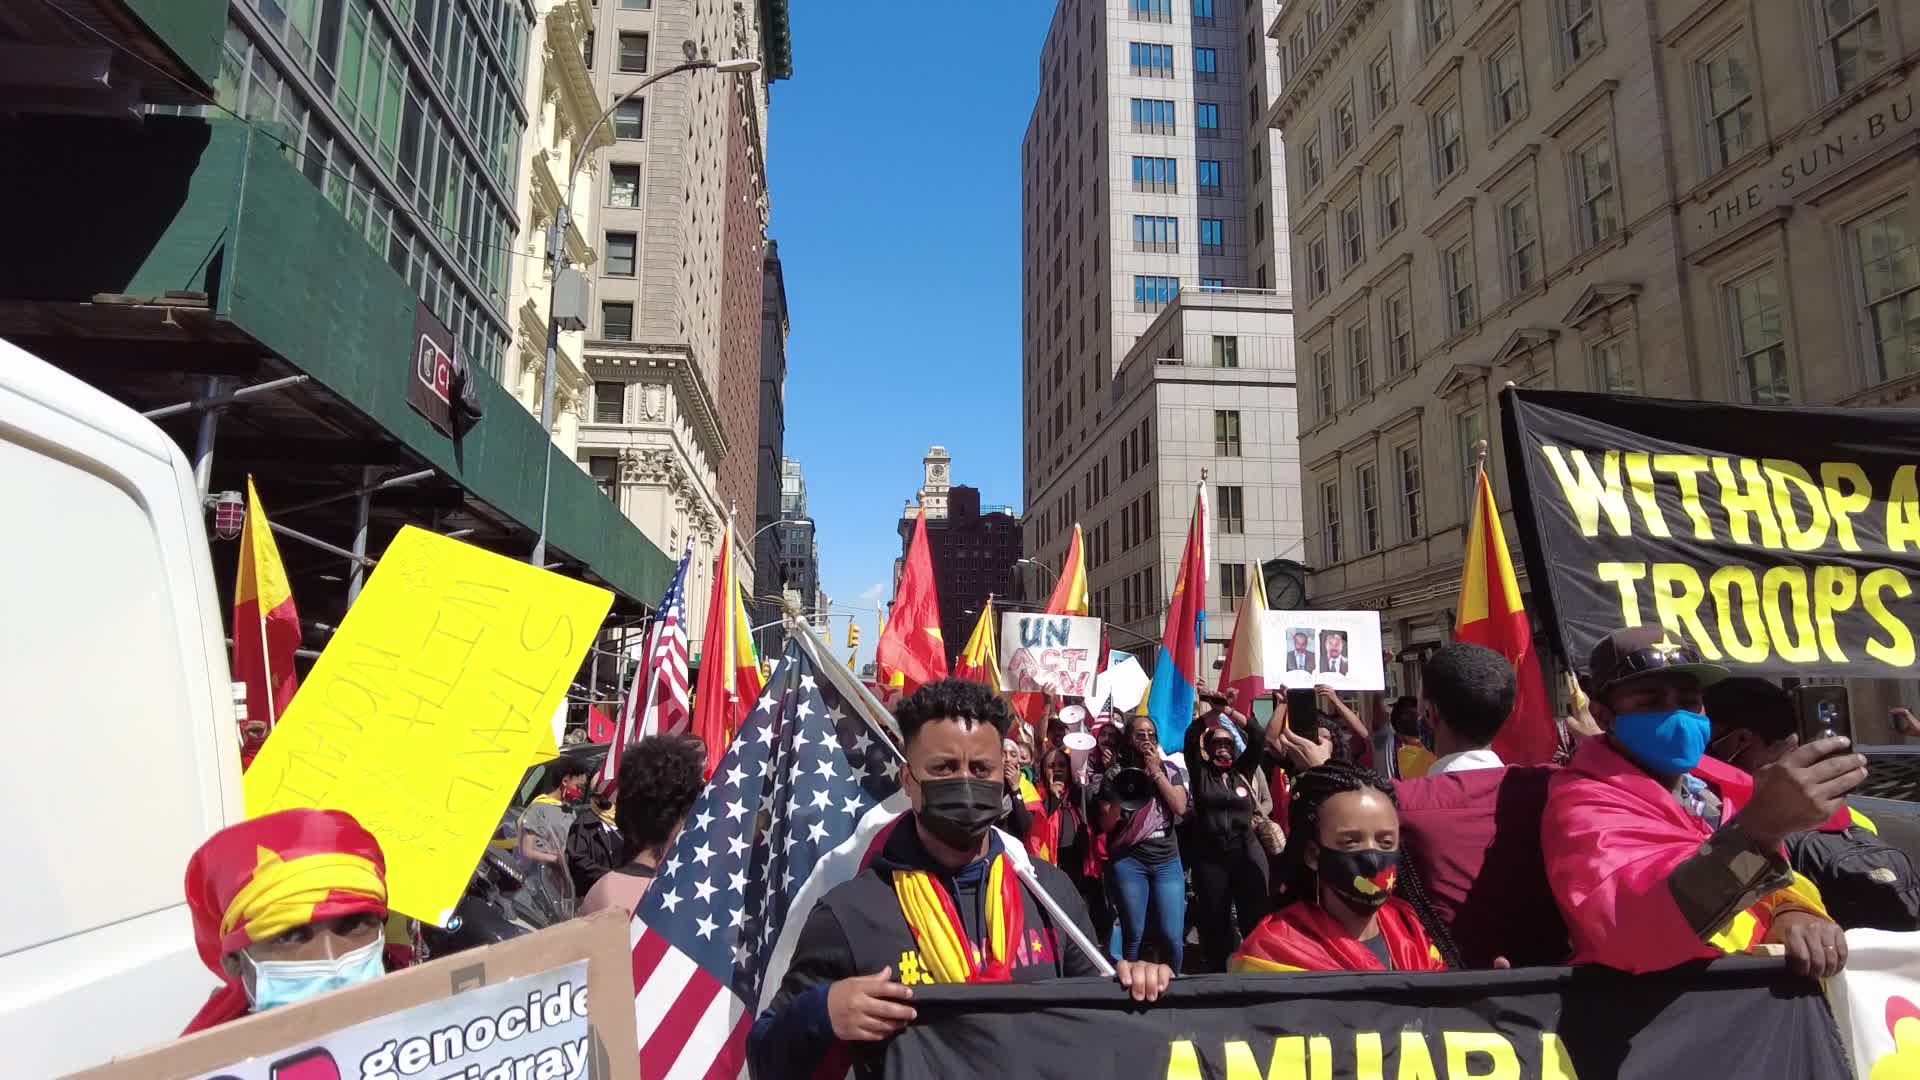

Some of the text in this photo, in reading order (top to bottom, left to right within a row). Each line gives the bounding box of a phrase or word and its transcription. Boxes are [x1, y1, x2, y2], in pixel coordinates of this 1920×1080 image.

[1707, 184, 1762, 229] THE
[1781, 135, 1845, 190] SUN
[386, 580, 510, 734] WITH
[1008, 648, 1089, 676] ACT
[1019, 617, 1071, 648] UN
[1598, 563, 1916, 667] TROOPS
[446, 604, 574, 814] STAND
[1019, 670, 1090, 695] NW
[360, 981, 589, 1080] genocide
